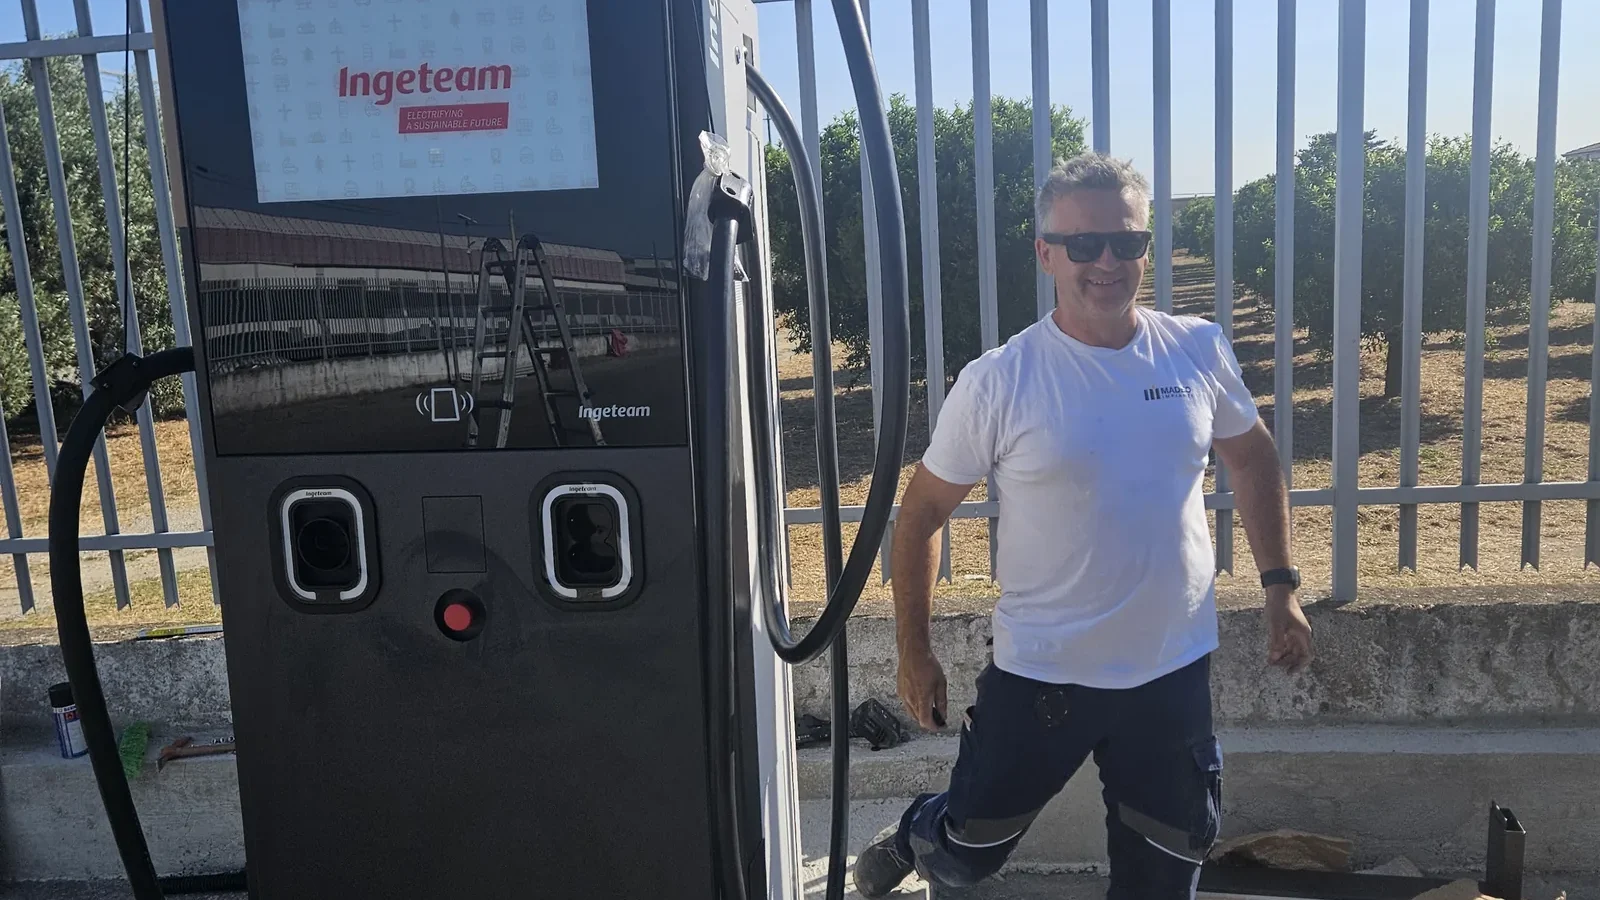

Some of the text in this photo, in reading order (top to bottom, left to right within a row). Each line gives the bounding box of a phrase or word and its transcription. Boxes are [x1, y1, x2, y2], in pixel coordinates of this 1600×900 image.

[338, 62, 512, 105] Ingeteam
[407, 109, 463, 120] ELECTRIFYING
[406, 117, 502, 130] A SUSTAINABLE FUTURE
[578, 404, 651, 422] Ingeteam
